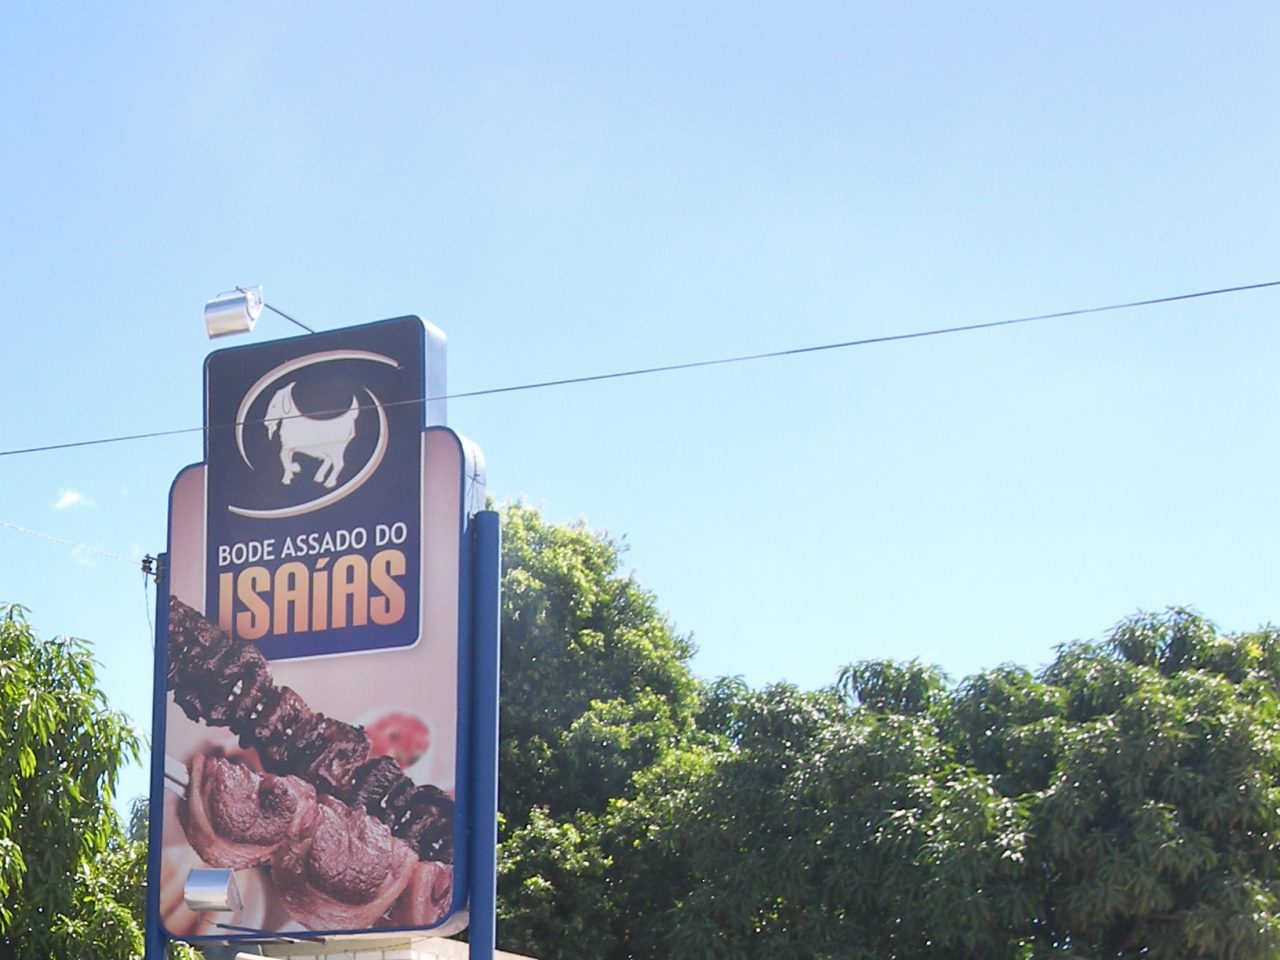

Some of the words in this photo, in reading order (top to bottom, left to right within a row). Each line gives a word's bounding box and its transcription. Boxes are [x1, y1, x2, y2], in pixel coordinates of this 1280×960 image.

[218, 538, 275, 566] BODE
[280, 526, 367, 559] ASSADO
[375, 521, 408, 545] DO
